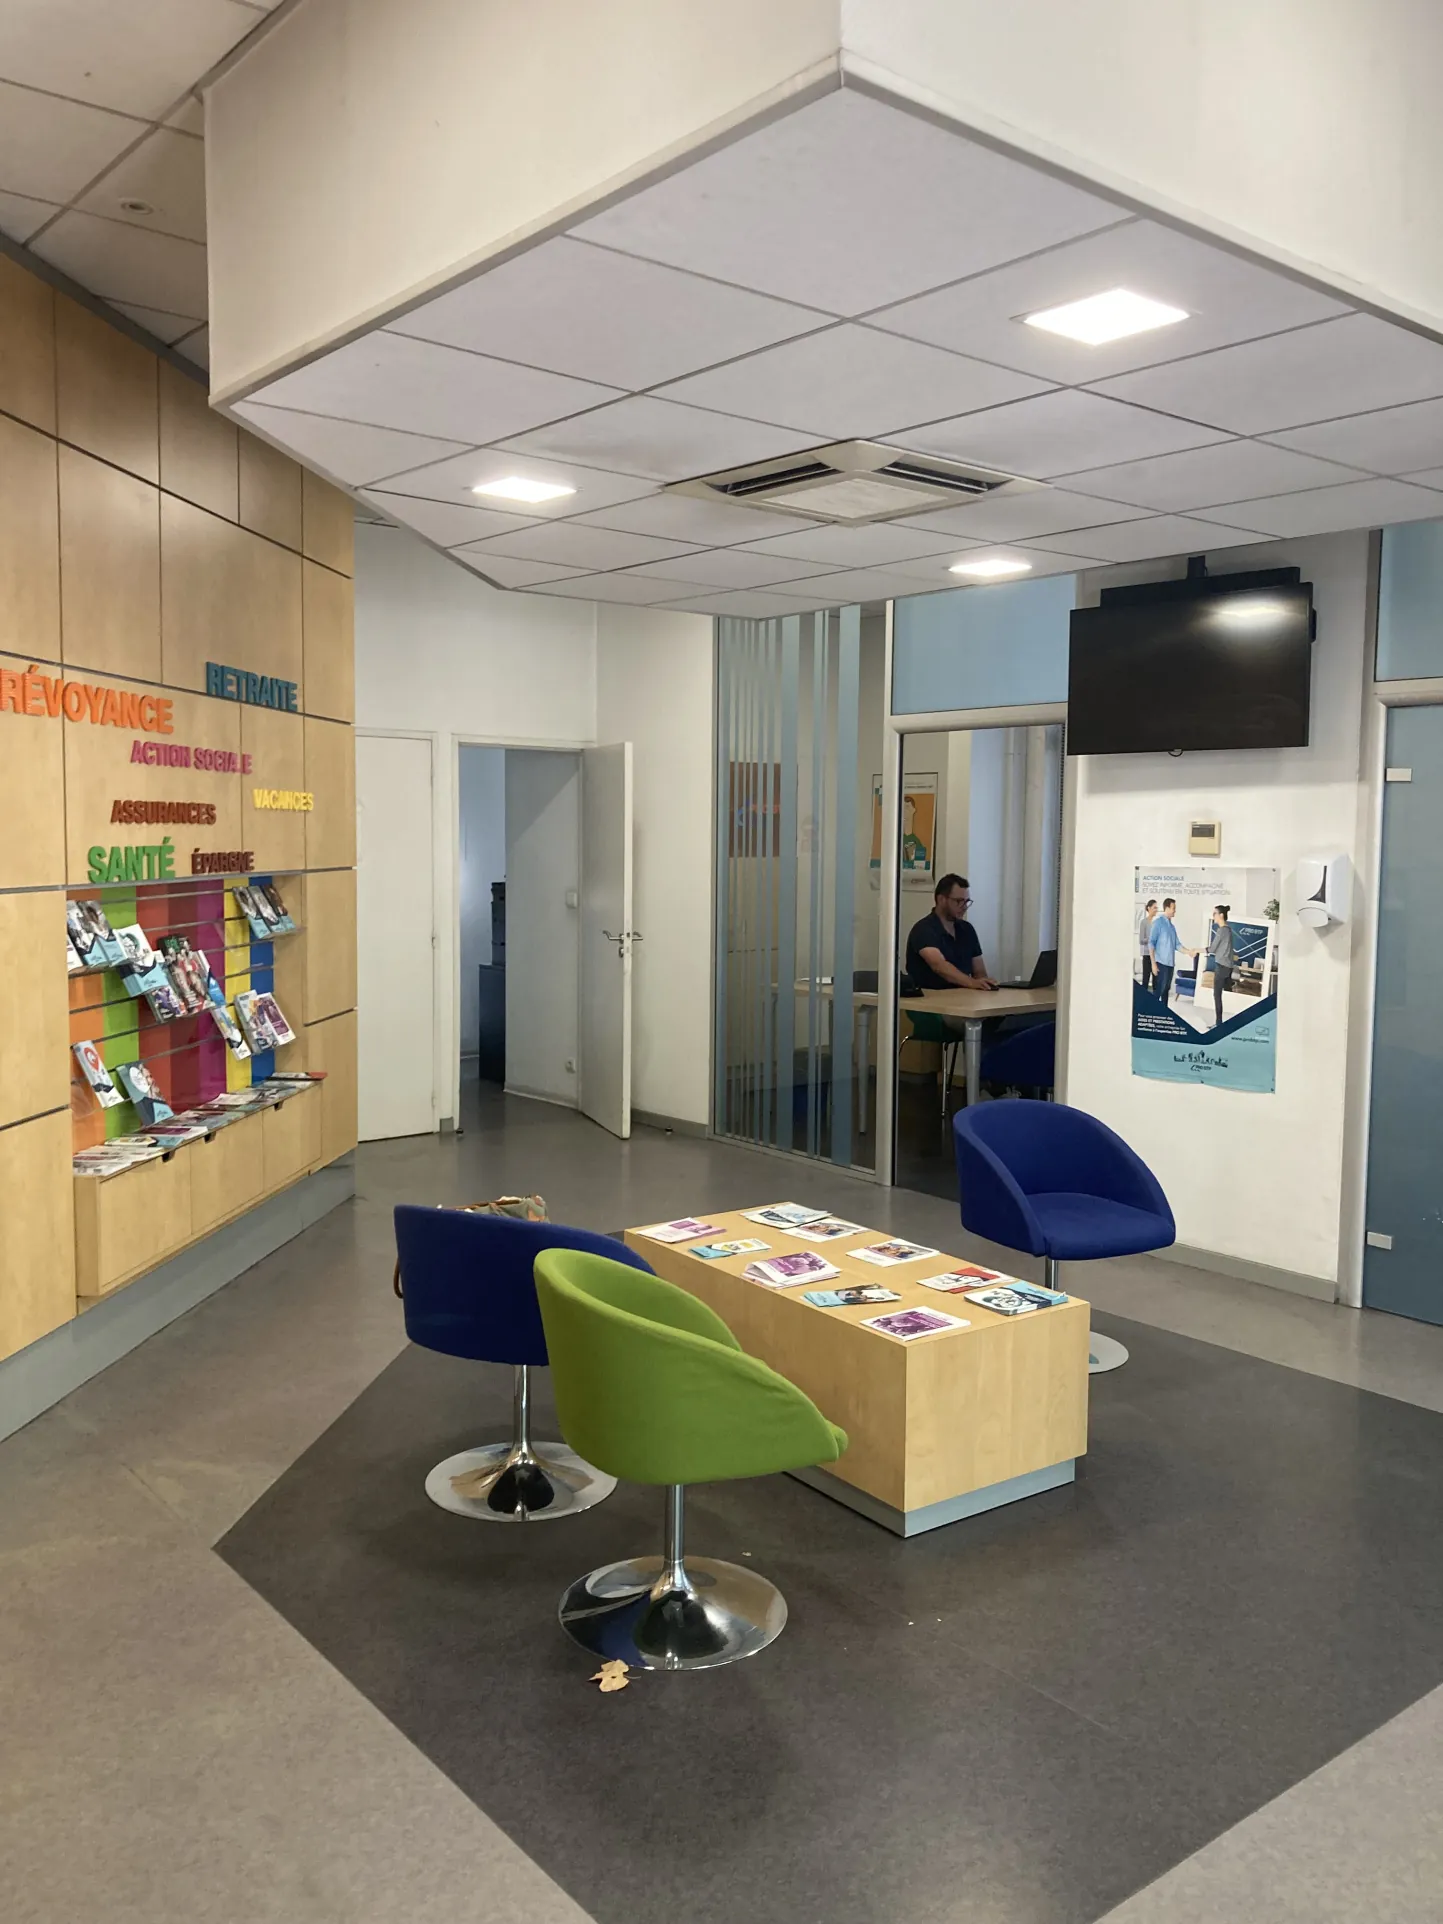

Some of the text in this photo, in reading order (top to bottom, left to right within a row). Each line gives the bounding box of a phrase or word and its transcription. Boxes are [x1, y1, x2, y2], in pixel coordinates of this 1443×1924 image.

[206, 661, 298, 712] RETRAITE
[130, 740, 191, 768] ACTION
[110, 799, 216, 825] ASSURANCES
[253, 788, 314, 812] VACANCES
[87, 836, 176, 884] SANTÉ
[191, 848, 255, 875] ÉPARGNE
